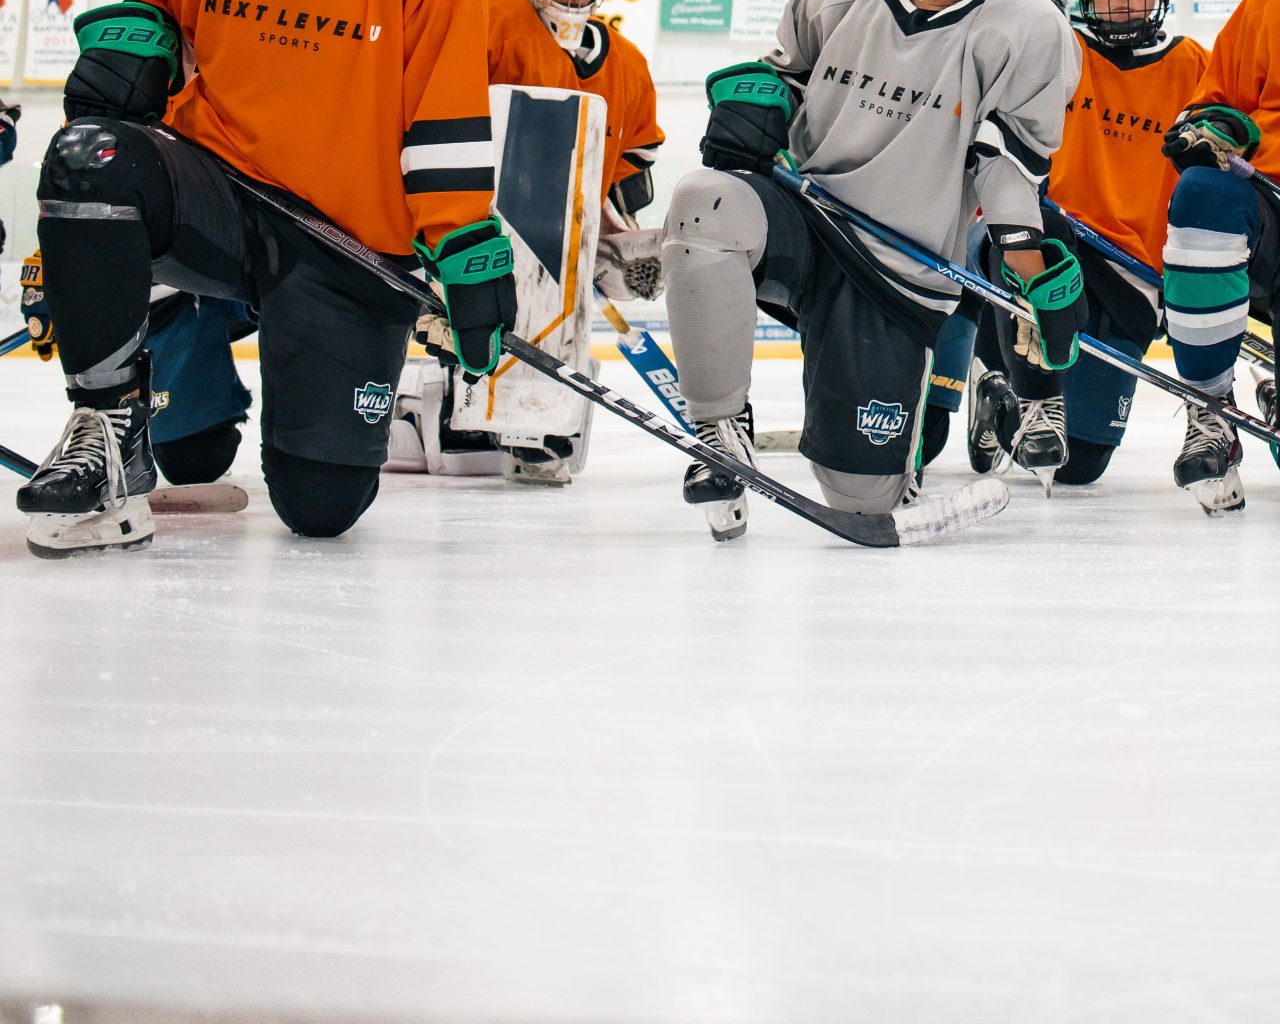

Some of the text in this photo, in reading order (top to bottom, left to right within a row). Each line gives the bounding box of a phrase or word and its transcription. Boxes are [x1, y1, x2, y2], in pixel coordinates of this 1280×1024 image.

[277, 9, 363, 40] LEVEL
[559, 21, 583, 41] 27
[1110, 32, 1138, 40] CCM
[259, 32, 320, 52] SPORTS
[823, 66, 873, 90] NET
[859, 99, 913, 122] SPORTS
[1103, 108, 1163, 134] LEVEL
[936, 262, 987, 296] VAPOR
[358, 393, 390, 409] WILD
[557, 364, 700, 449] CCM
[646, 368, 696, 430] BAUE
[861, 412, 903, 431] WILD
[735, 475, 778, 503] CCM
